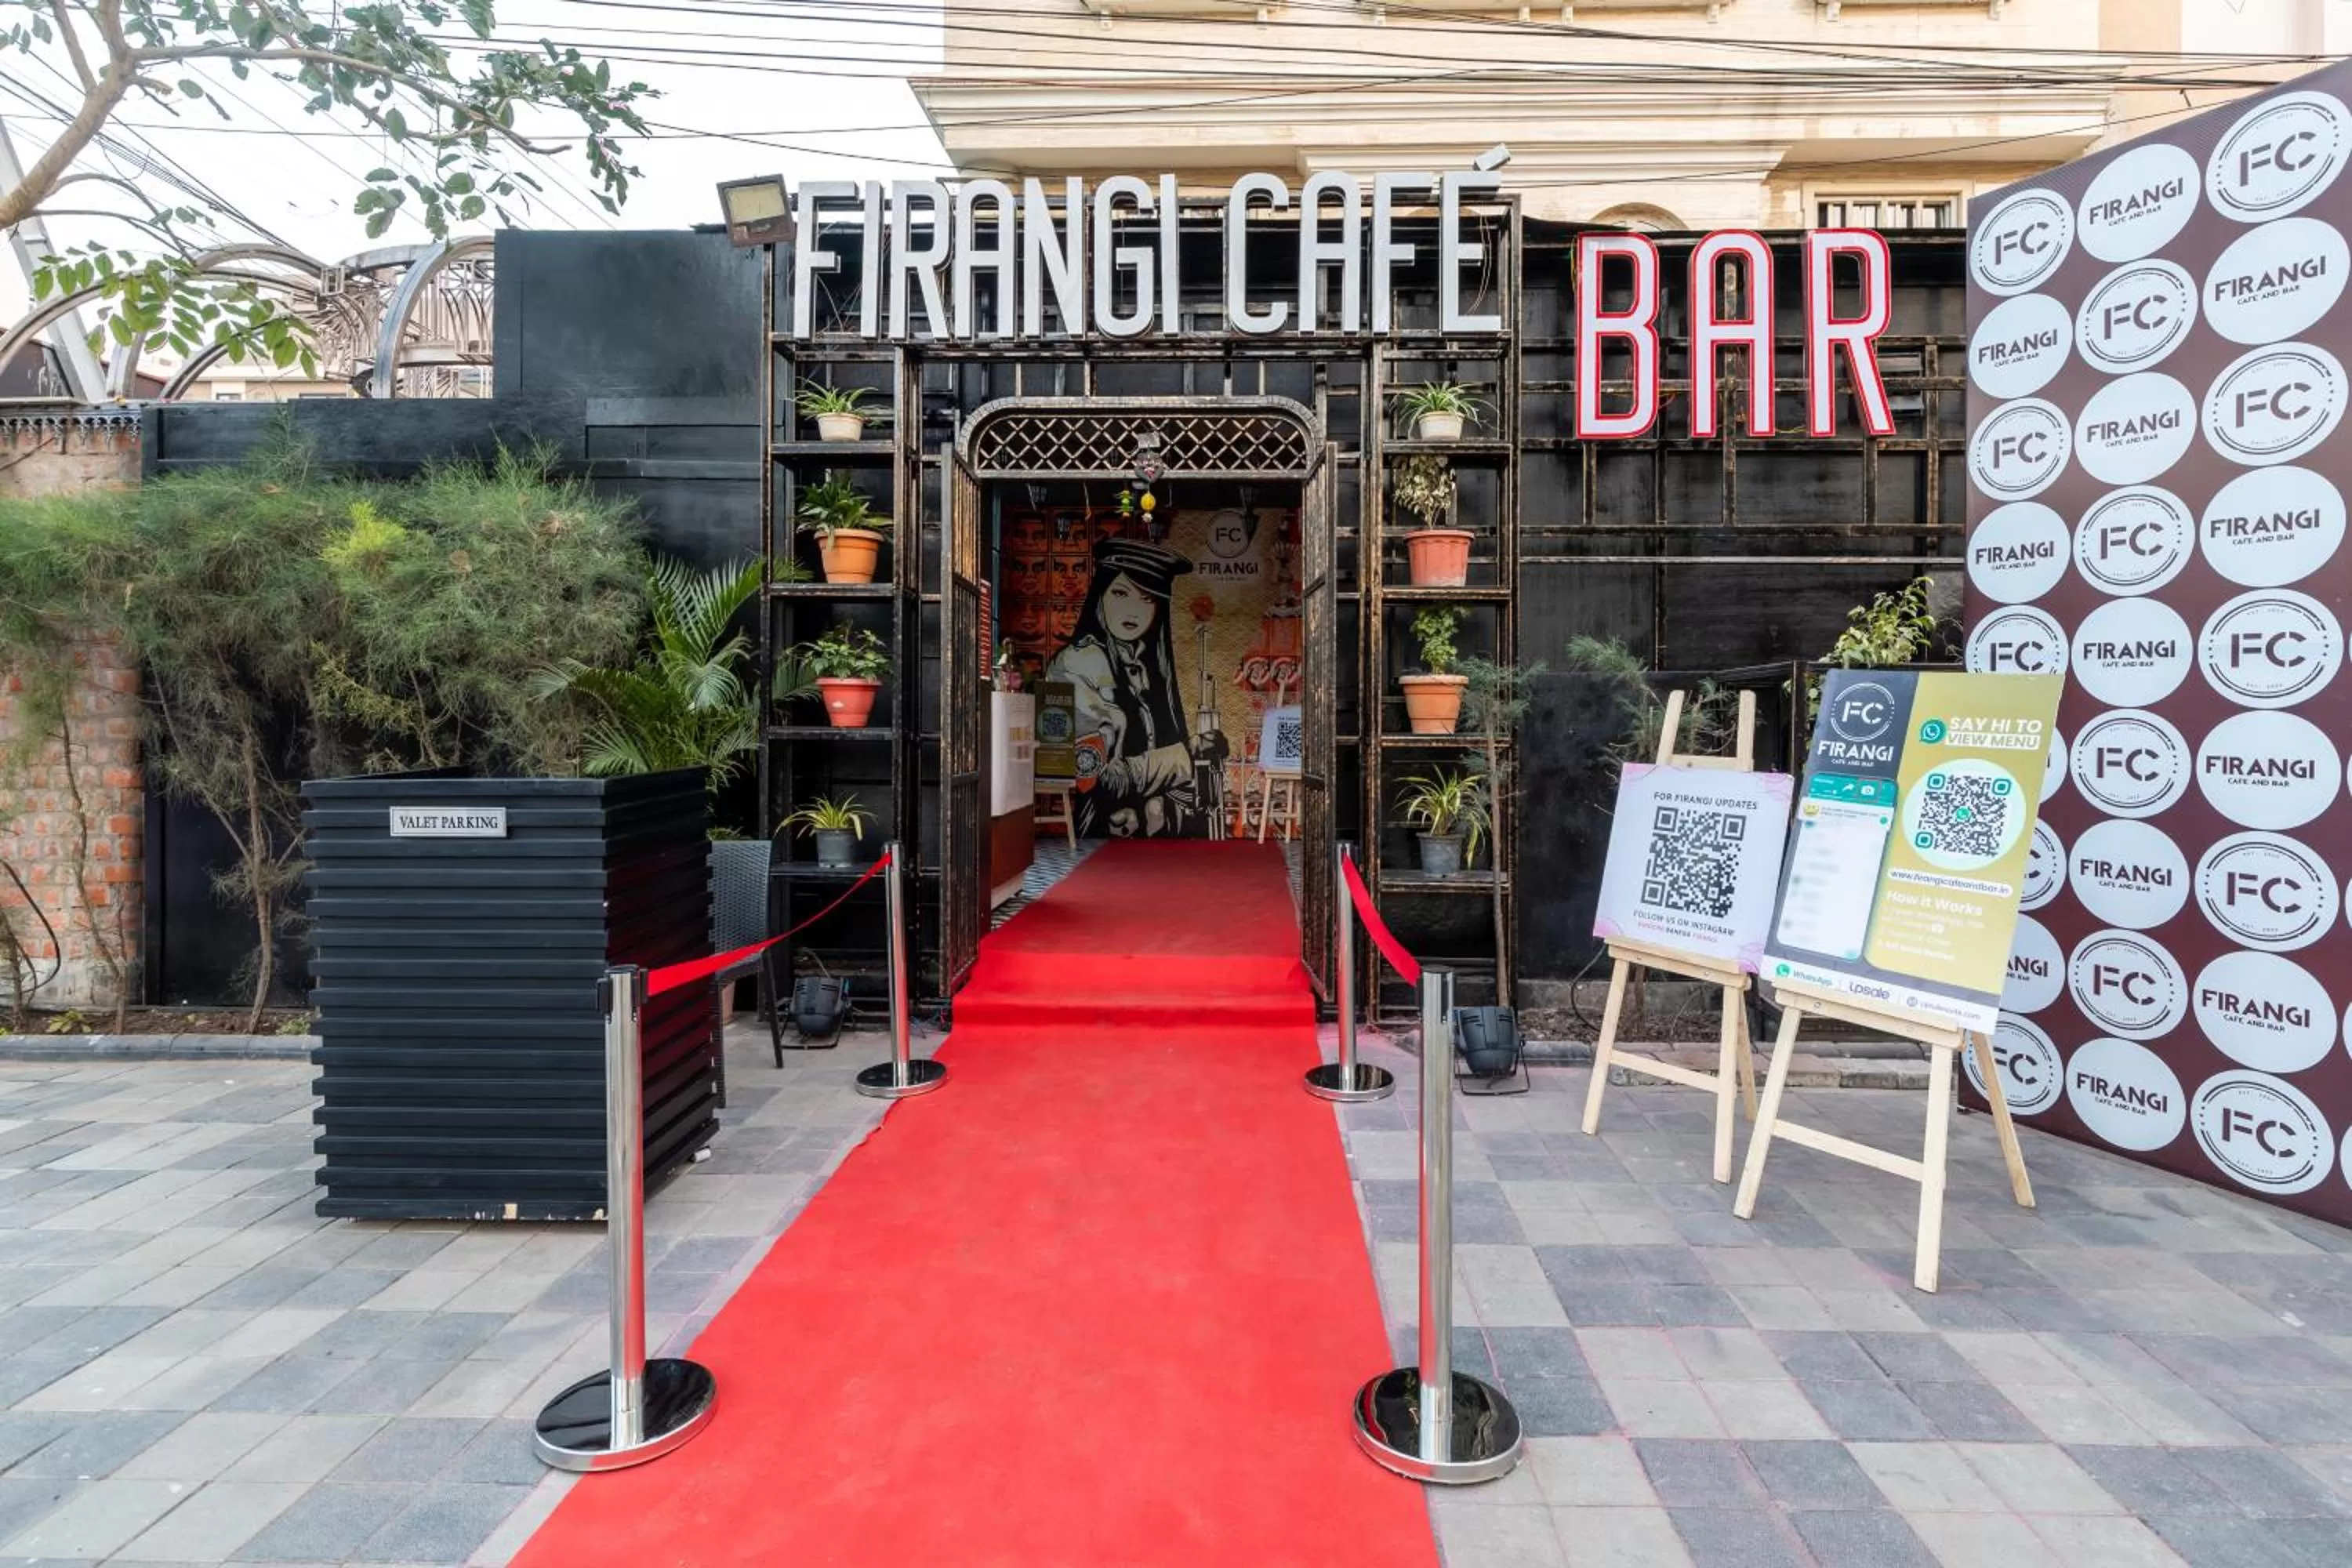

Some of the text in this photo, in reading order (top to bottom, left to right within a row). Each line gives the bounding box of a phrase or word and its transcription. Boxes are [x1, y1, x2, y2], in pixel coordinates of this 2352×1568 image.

[2240, 131, 2317, 187] FC
[2090, 177, 2183, 225] FIRANGI
[793, 173, 1180, 339] FIRANGI
[1994, 222, 2049, 265] FC
[2215, 256, 2326, 302] FIRANGI
[1576, 227, 1896, 439] BAR
[2104, 295, 2168, 340] FC
[1979, 329, 2057, 364] FIRANGI
[2235, 382, 2312, 428] FC
[2087, 409, 2180, 443] FIRANGI
[1993, 432, 2047, 469] FC
[1216, 527, 1242, 543] FC
[2101, 522, 2164, 560] FC
[2211, 509, 2320, 539] FIRANGI
[1199, 562, 1258, 575] FIRANGI
[1976, 541, 2053, 564] FIRANGI
[1990, 641, 2044, 671] FC
[2083, 640, 2176, 660] FIRANGI
[2230, 631, 2307, 668] FC
[1842, 701, 1884, 724] FC
[1950, 717, 2042, 733] SAY HI TO
[1817, 740, 1894, 762] FIRANGI
[1949, 733, 2038, 748] VIEW MENU
[2096, 747, 2160, 781] FC
[2206, 755, 2315, 779] FIRANGI
[1653, 791, 1758, 810] FOR FIRANGI UPDATES
[399, 816, 499, 829] VALET PARKING
[2080, 858, 2172, 887] FIRANGI
[2227, 871, 2302, 913] FC
[1691, 921, 1735, 936] INSTAGRAM
[2093, 964, 2156, 1005] FC
[2201, 989, 2310, 1029] FIRANGI
[2077, 1073, 2168, 1113] FIRANGI
[2222, 1107, 2296, 1158] FC
